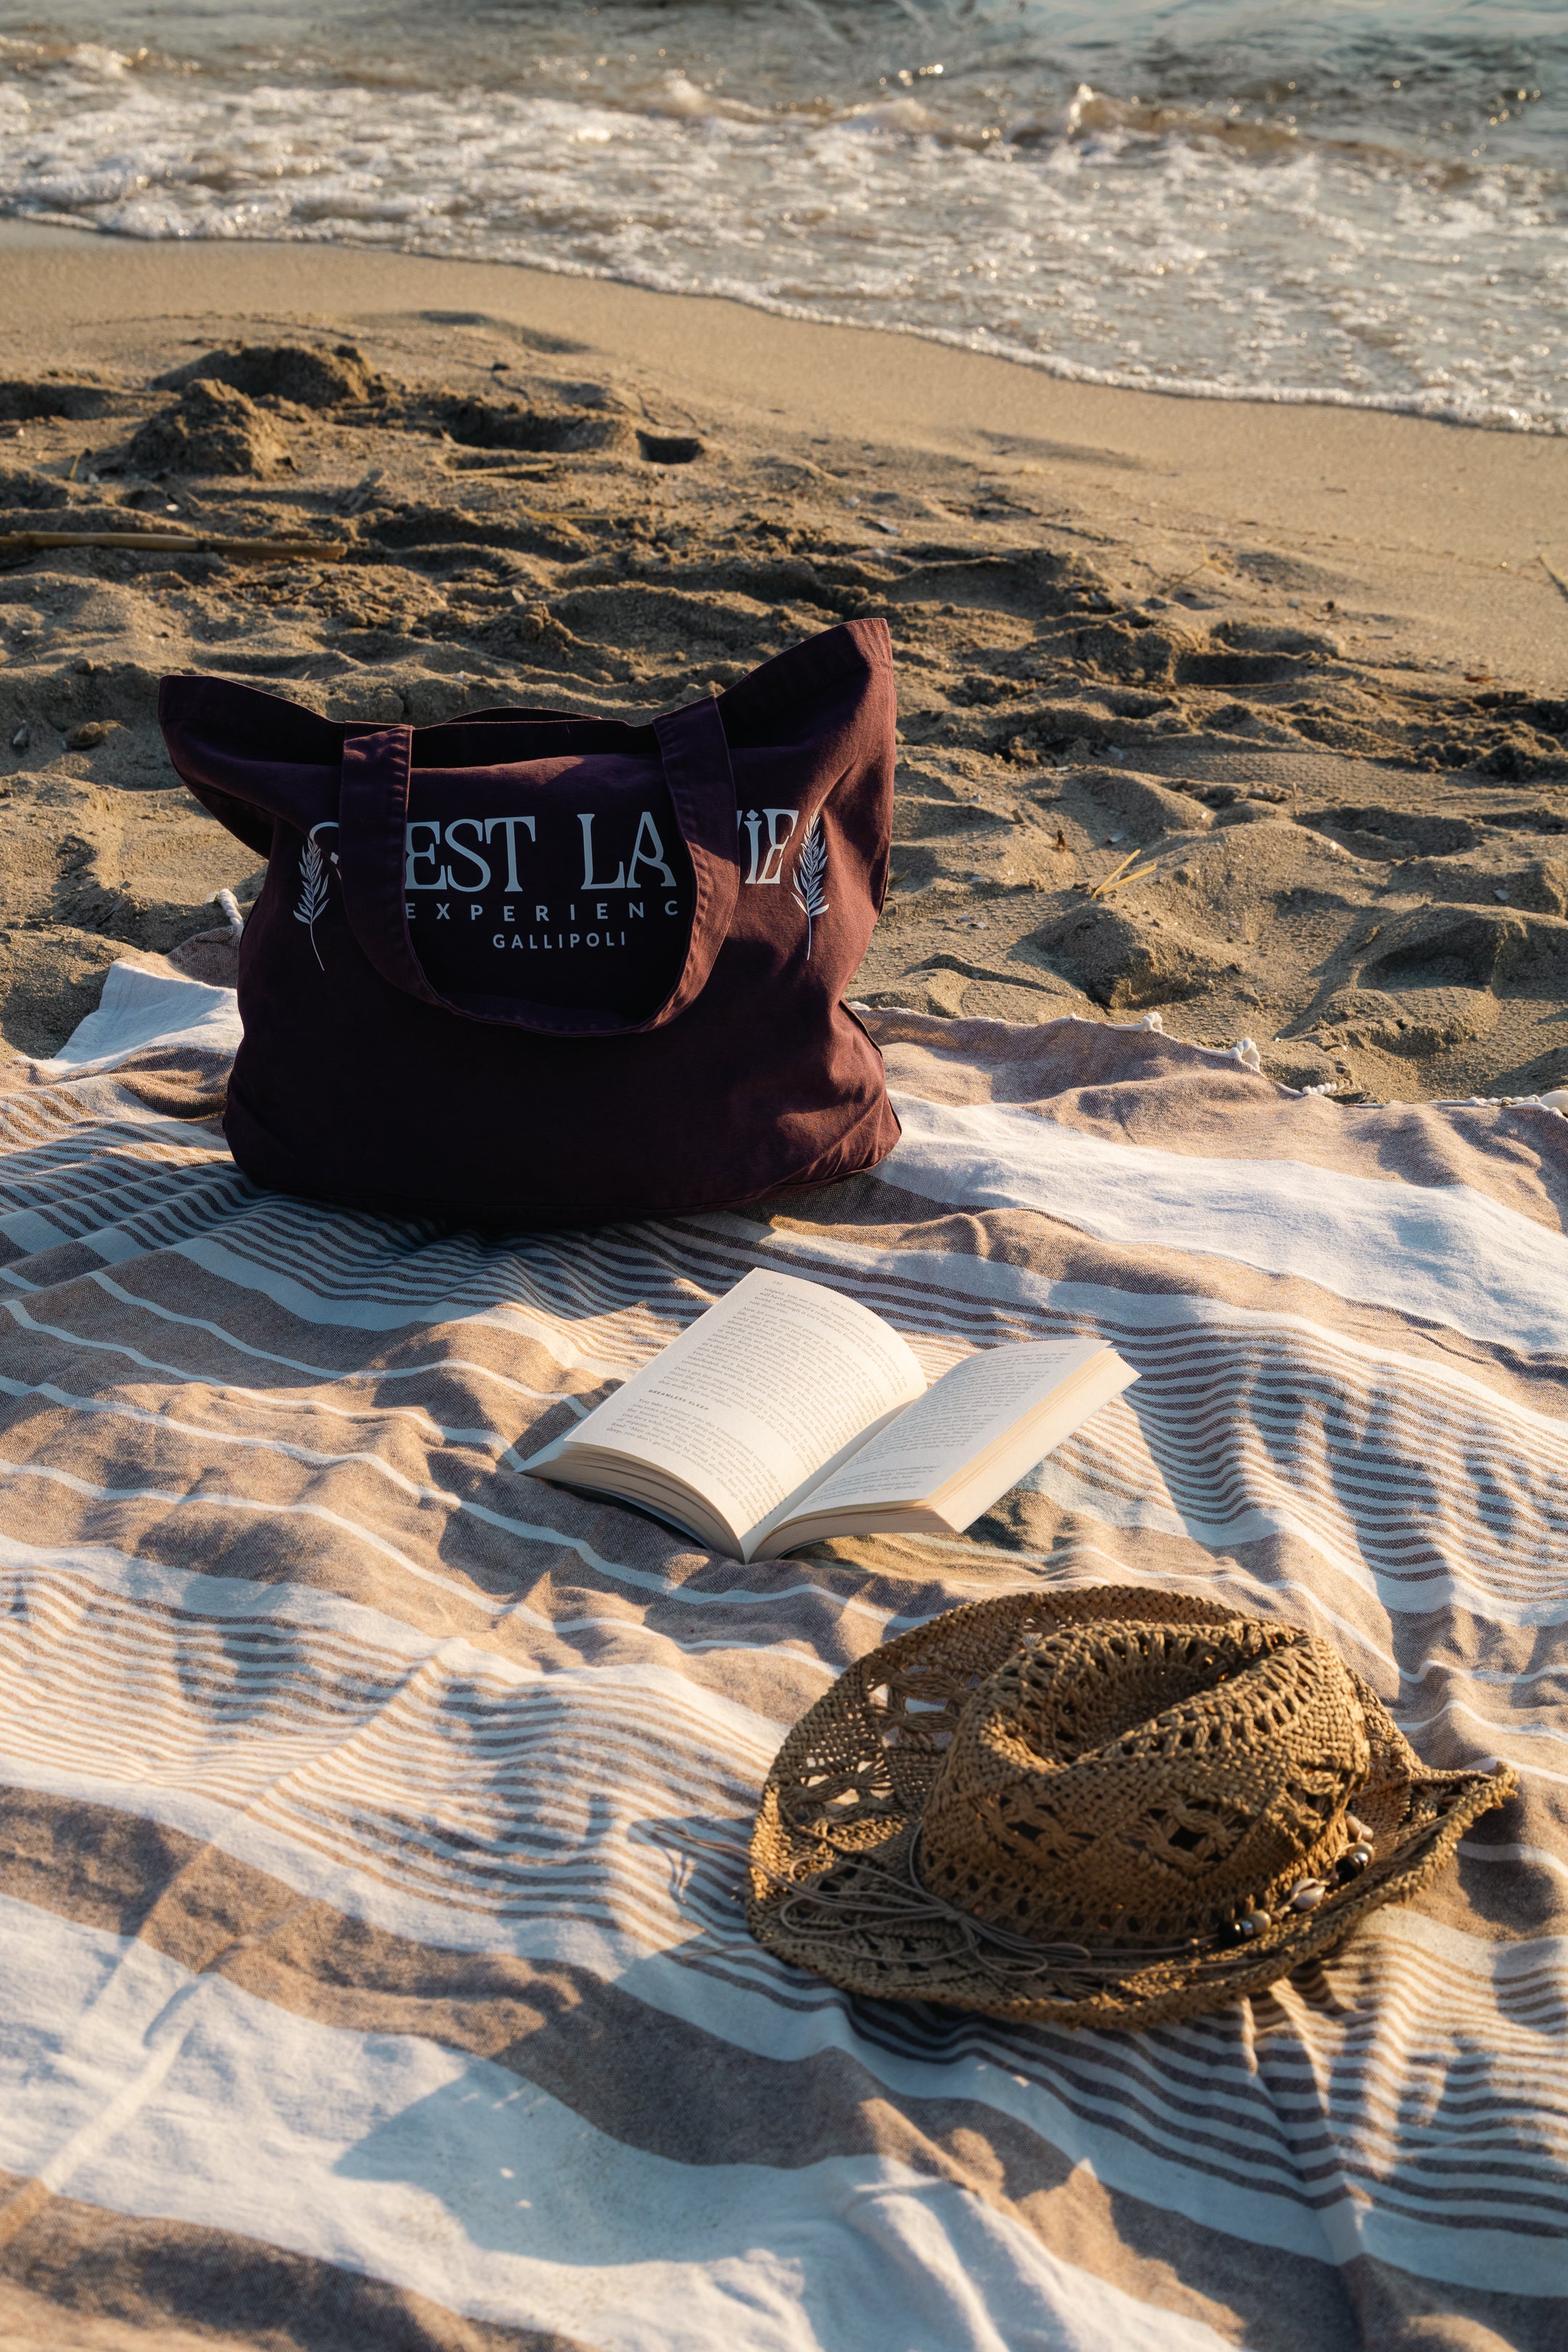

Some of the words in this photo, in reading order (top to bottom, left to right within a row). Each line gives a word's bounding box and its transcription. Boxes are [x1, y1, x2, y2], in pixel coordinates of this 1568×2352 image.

[577, 812, 677, 890] LA
[405, 900, 678, 922] EXPERIENC
[492, 931, 626, 950] GALLIPOLI
[688, 1401, 709, 1410] SLEEP
